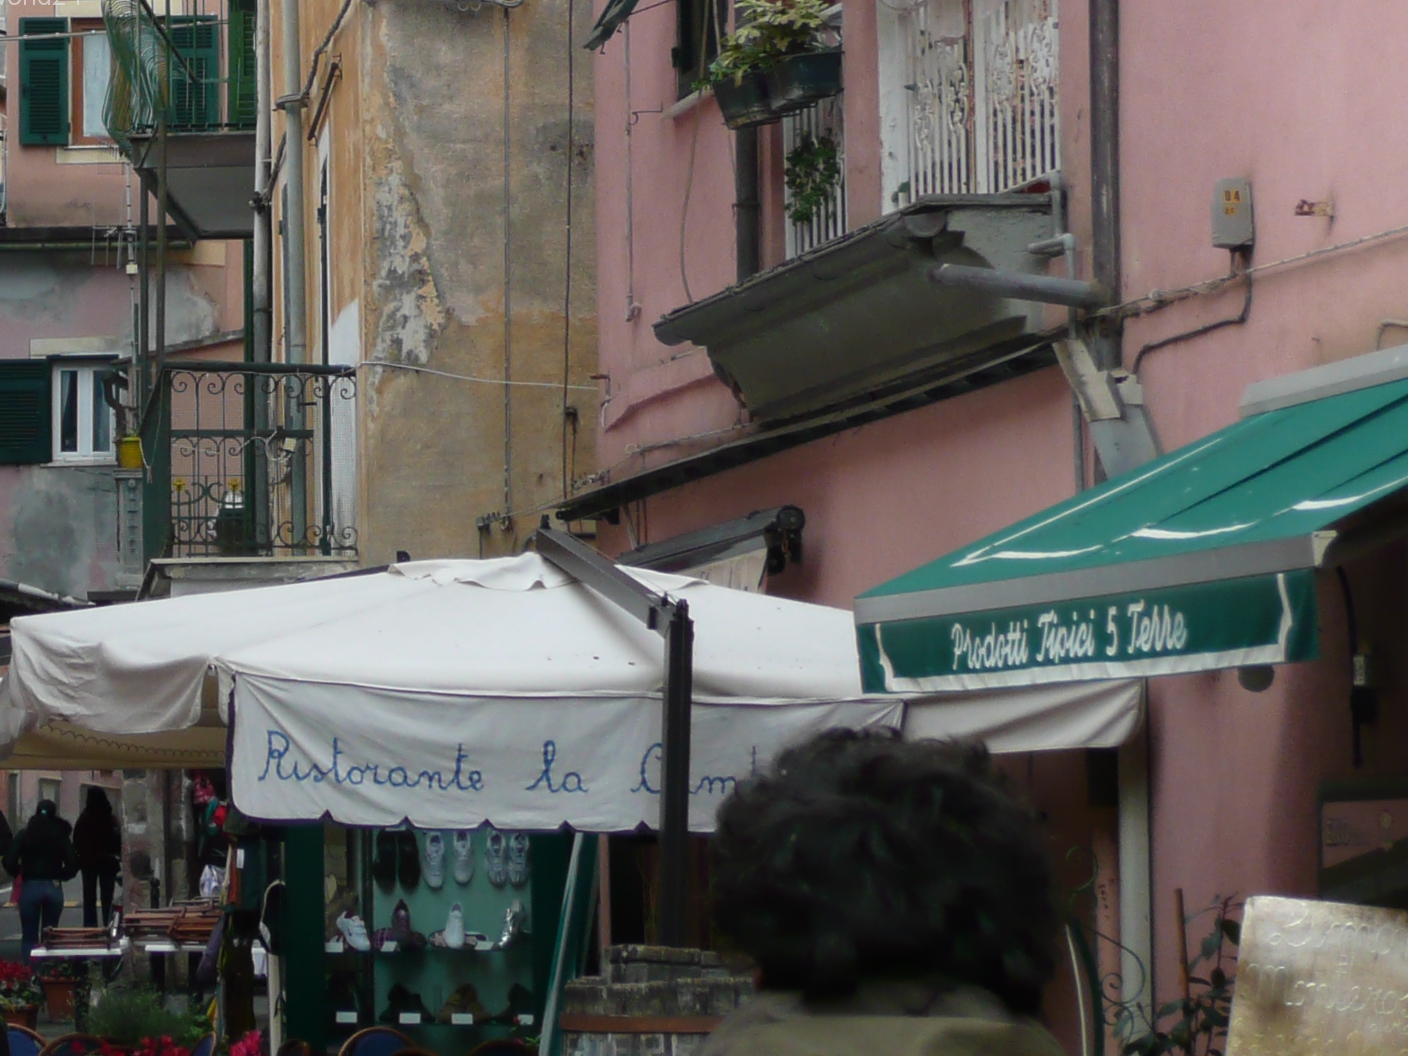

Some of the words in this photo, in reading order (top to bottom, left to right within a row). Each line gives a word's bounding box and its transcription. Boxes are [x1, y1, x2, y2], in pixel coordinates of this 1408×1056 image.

[951, 619, 1029, 671] Prodotti
[1036, 608, 1096, 664] Tipici
[1105, 606, 1119, 656] 5
[1126, 598, 1189, 654] Terre
[258, 727, 484, 791] Ristorante
[525, 739, 589, 794] la
